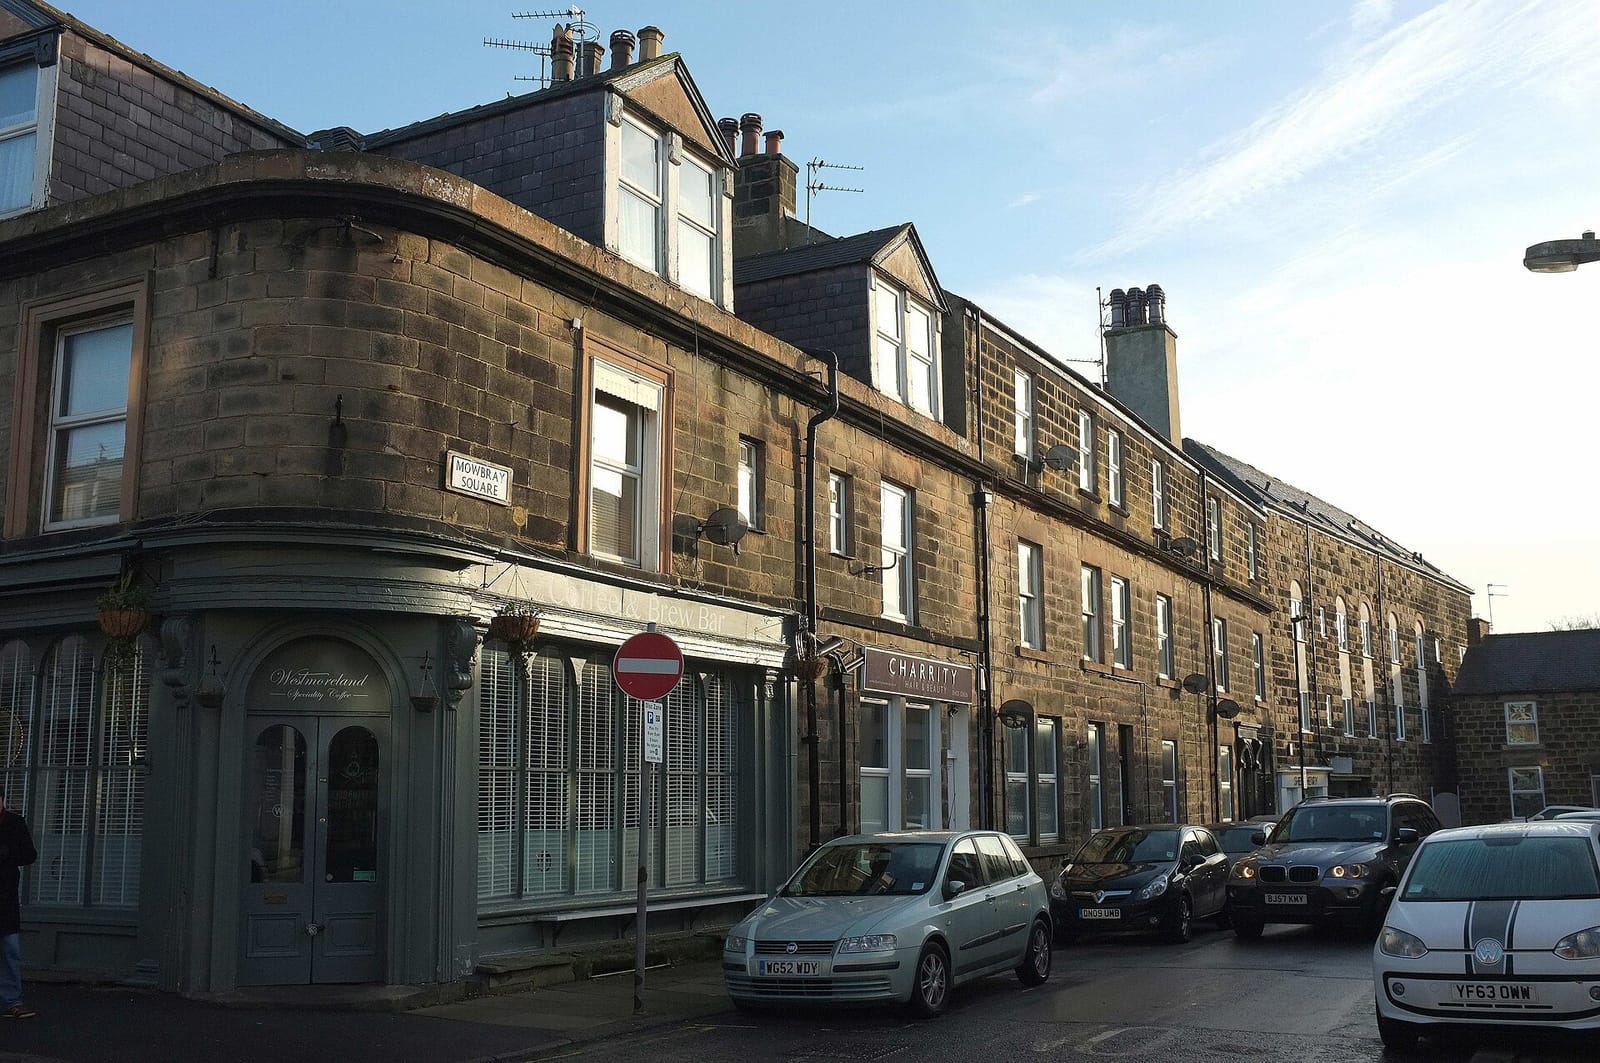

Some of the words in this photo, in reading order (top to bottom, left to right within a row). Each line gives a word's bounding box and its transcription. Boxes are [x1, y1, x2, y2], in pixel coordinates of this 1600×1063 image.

[456, 460, 505, 483] MOWBRAY
[461, 476, 498, 496] SQUARE
[648, 597, 694, 627] Brew
[698, 606, 726, 633] Bar
[270, 668, 369, 686] Westmoreland
[889, 657, 958, 685] CHARRITY
[327, 688, 352, 701] Coffee
[904, 680, 919, 689] HAIR
[926, 684, 947, 694] BEAUTY
[766, 961, 793, 974] WG52
[796, 961, 818, 974] WDY
[1456, 984, 1495, 999] YF63
[1500, 986, 1530, 999] OWW
